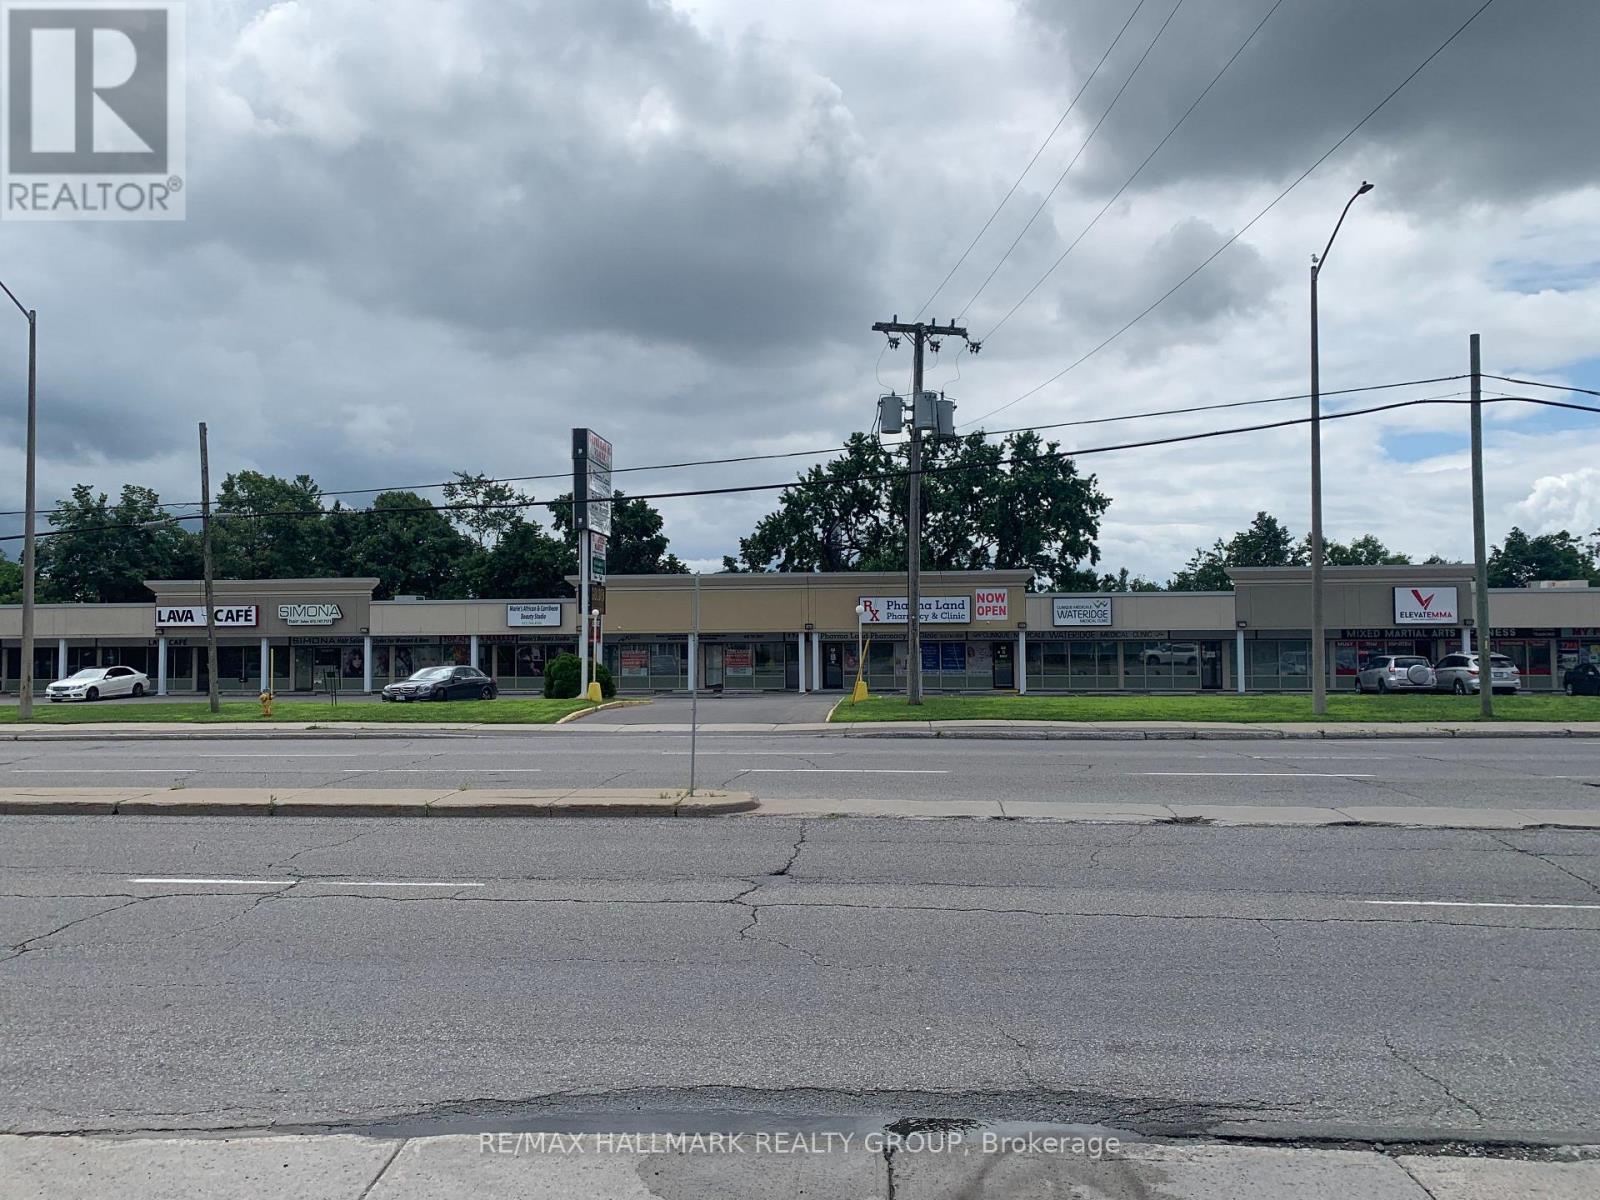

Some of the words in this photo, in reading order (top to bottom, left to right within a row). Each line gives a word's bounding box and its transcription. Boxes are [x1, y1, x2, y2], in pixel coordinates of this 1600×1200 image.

[976, 593, 1006, 603] NOW
[886, 600, 932, 610] Phaa
[935, 600, 965, 610] Land
[158, 609, 194, 622] LAVA
[214, 606, 252, 622] CAFÉ
[279, 605, 340, 618] SIMONA
[977, 606, 1007, 615] OPEN
[1057, 609, 1108, 619] WATERIDGE
[886, 612, 929, 621] Pharcy
[931, 612, 938, 620] &
[940, 612, 965, 620] Clinic
[1050, 631, 1096, 639] WATERIDGE
[1346, 630, 1380, 638] MIXED
[1385, 629, 1427, 638] MARTIAL
[1431, 629, 1456, 637] ARTS
[1469, 628, 1516, 637] FNESS
[292, 636, 336, 645] SIMONA
